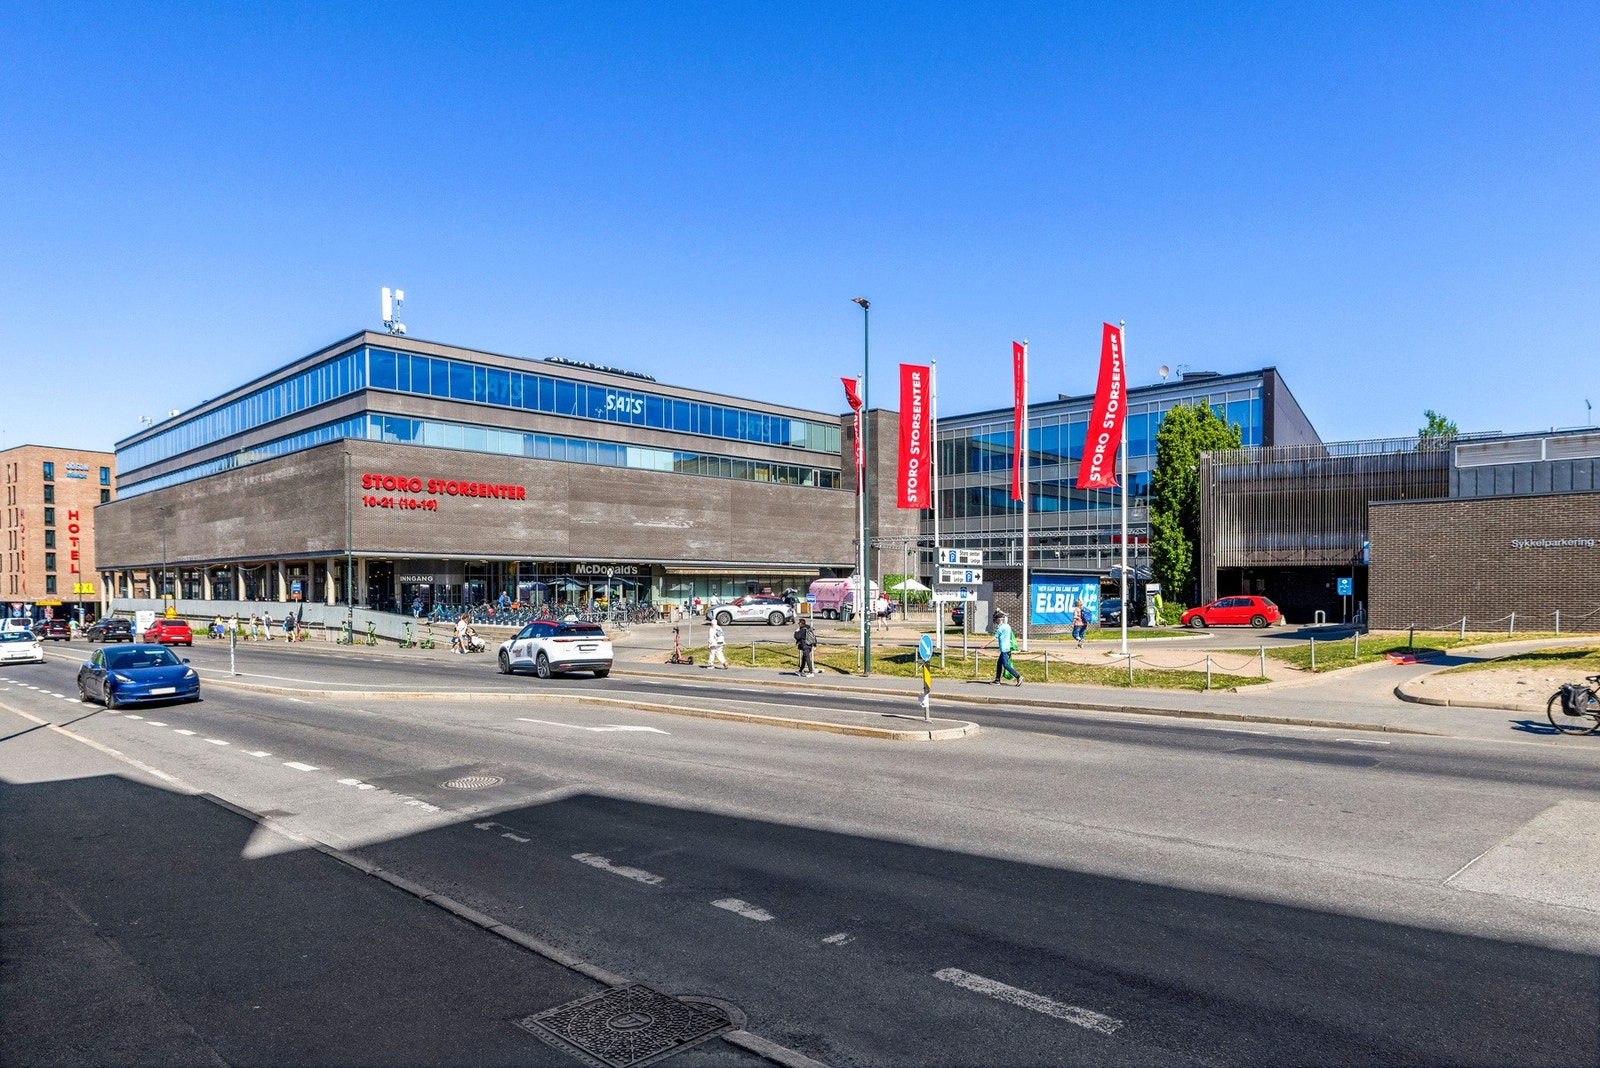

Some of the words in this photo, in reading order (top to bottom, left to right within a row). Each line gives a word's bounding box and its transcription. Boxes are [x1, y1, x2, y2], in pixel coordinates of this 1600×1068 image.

[605, 394, 644, 415] SATS
[911, 372, 922, 455] STORSENTER
[1090, 433, 1110, 481] STORO
[1103, 333, 1120, 429] STORSENTER
[361, 472, 422, 492] STORO
[427, 478, 526, 500] STORSENTER
[907, 458, 919, 503] STORO
[362, 495, 394, 509] 10-21
[68, 509, 80, 574] HOTEL
[1511, 538, 1595, 549] Sykkelparkering
[575, 563, 638, 575] McDoald's
[73, 582, 95, 595] XXL
[1036, 592, 1075, 614] ELBIL
